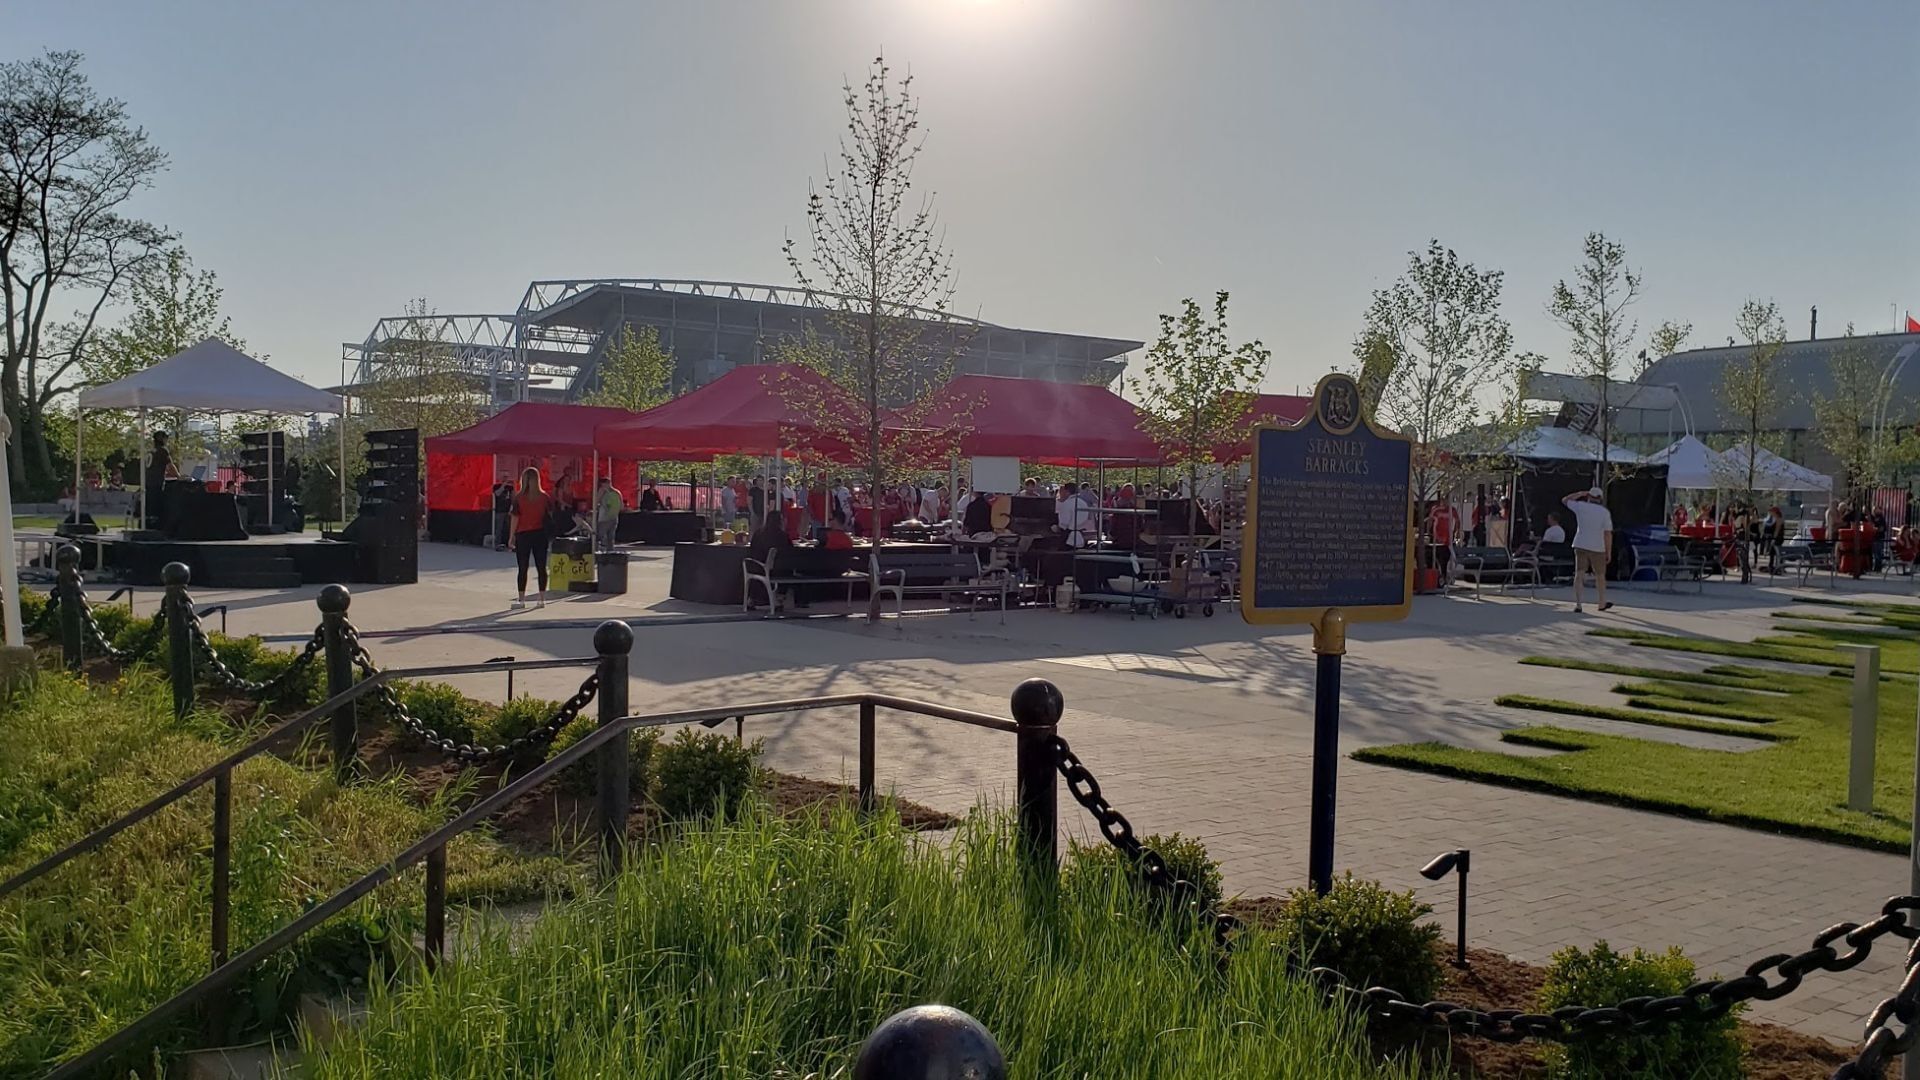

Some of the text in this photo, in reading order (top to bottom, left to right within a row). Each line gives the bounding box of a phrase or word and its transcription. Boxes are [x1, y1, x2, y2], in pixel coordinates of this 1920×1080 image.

[1308, 438, 1367, 456] STANLEY
[1305, 456, 1369, 475] BARRACKS
[572, 560, 589, 574] GFL
